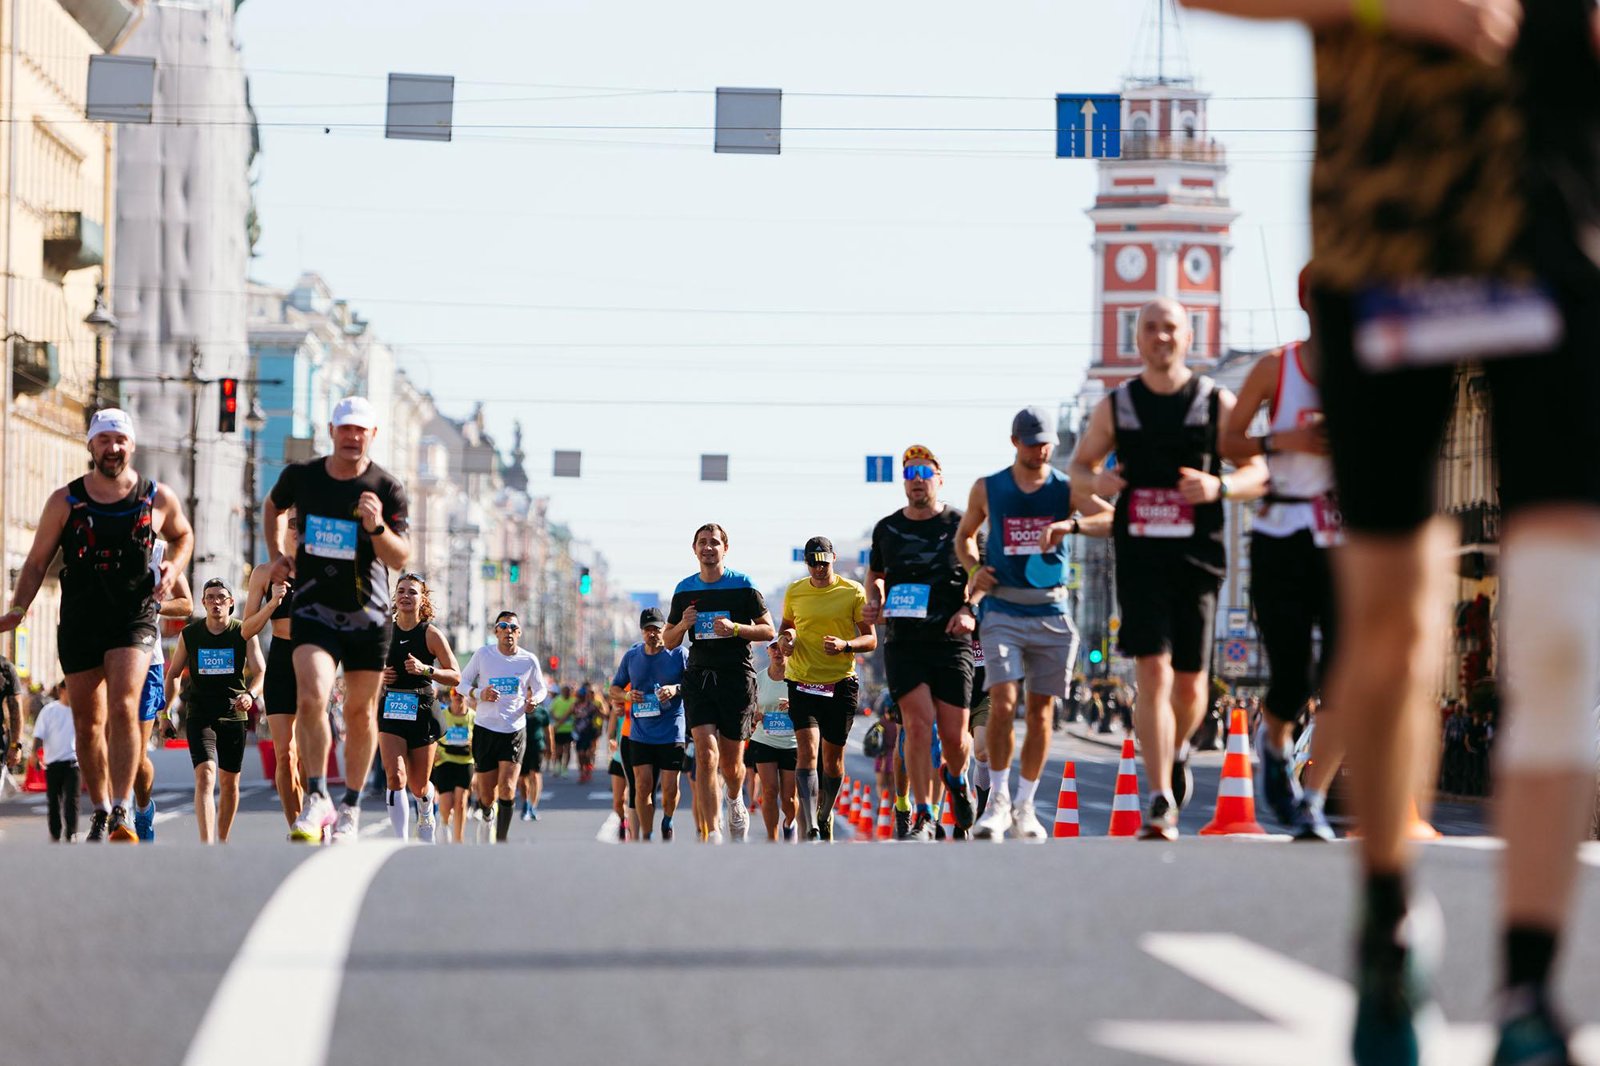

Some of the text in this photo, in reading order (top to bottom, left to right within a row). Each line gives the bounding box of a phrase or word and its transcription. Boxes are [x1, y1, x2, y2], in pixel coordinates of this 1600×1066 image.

[315, 530, 343, 544] 9180
[891, 595, 915, 605] 12143
[390, 702, 408, 710] 9736
[638, 702, 652, 710] 8797
